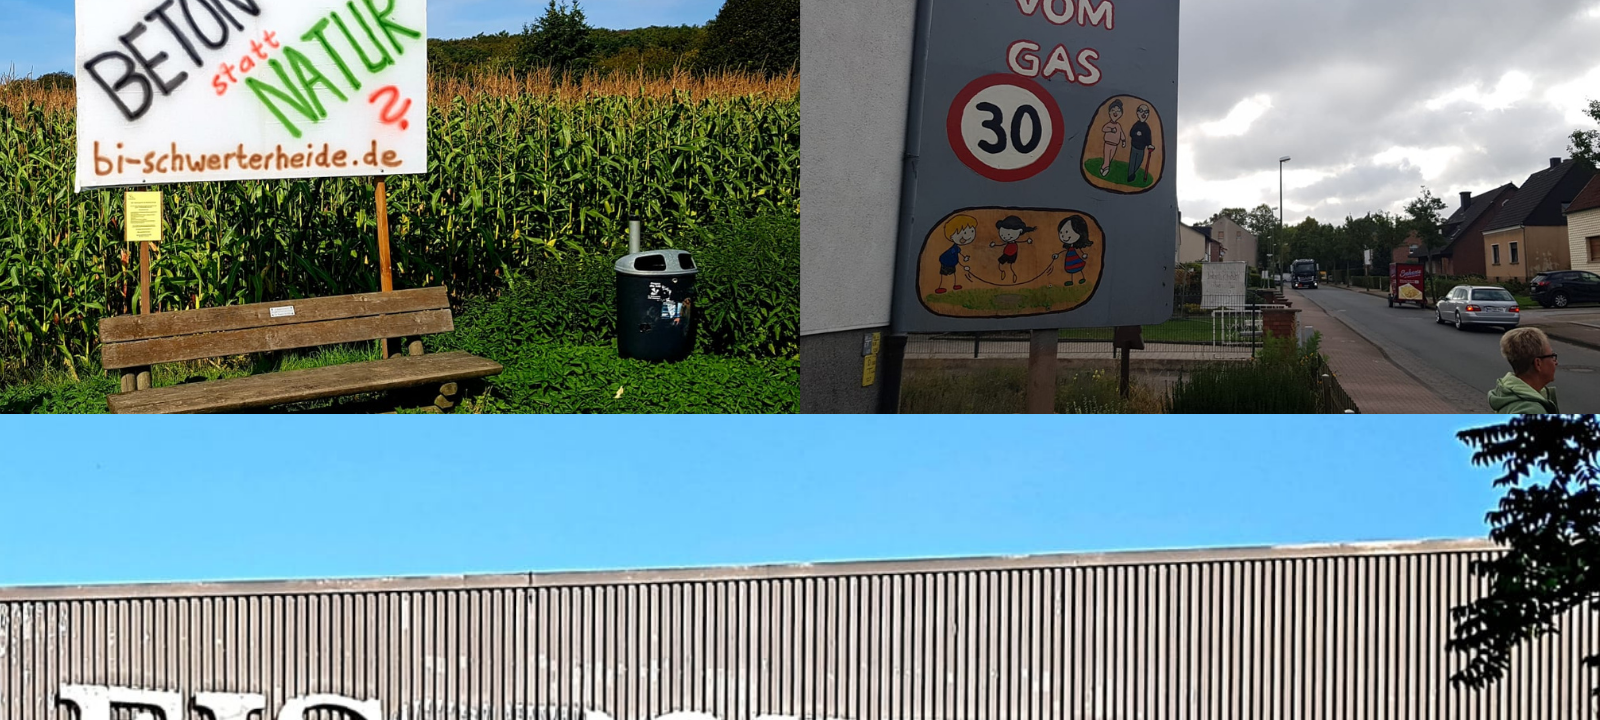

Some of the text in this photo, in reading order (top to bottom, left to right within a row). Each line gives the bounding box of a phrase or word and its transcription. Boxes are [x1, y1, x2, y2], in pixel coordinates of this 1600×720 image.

[211, 30, 280, 96] statt
[245, 0, 421, 138] NATUR
[1006, 39, 1102, 87] GAS
[976, 102, 1042, 154] 30
[93, 140, 403, 176] bi-schwerterheide.de
